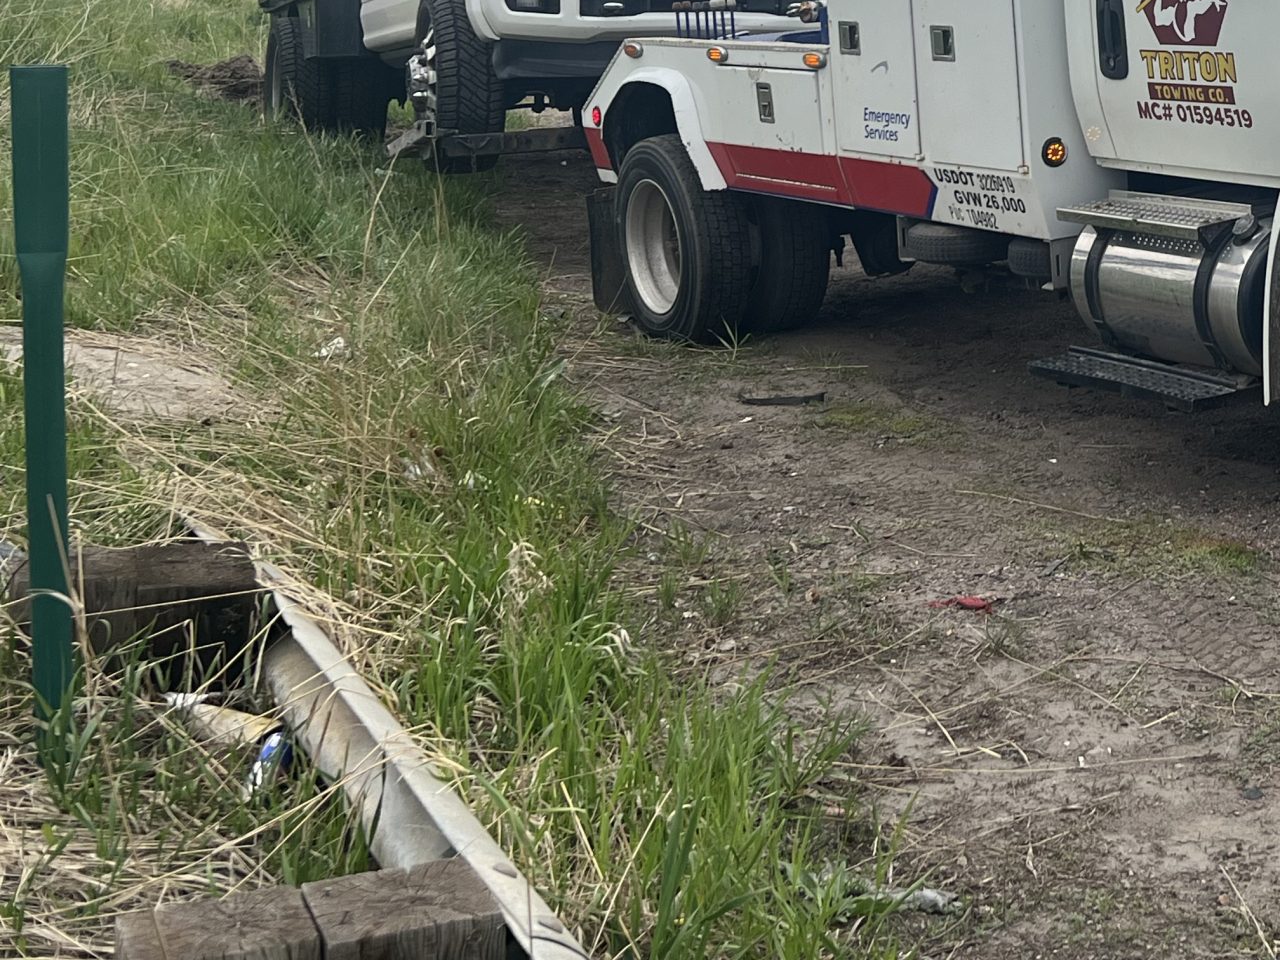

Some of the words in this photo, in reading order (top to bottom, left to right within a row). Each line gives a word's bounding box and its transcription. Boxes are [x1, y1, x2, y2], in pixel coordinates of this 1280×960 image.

[1139, 49, 1237, 83] TRITON
[1154, 85, 1204, 101] TOWING
[1208, 88, 1229, 103] CO.
[863, 107, 911, 129] Emergency
[1137, 101, 1173, 121] MC#
[1176, 103, 1253, 129] 01594519
[864, 124, 899, 142] Services
[933, 167, 975, 187] USDOT
[953, 189, 983, 208] GVW
[983, 193, 1027, 214] 26,000
